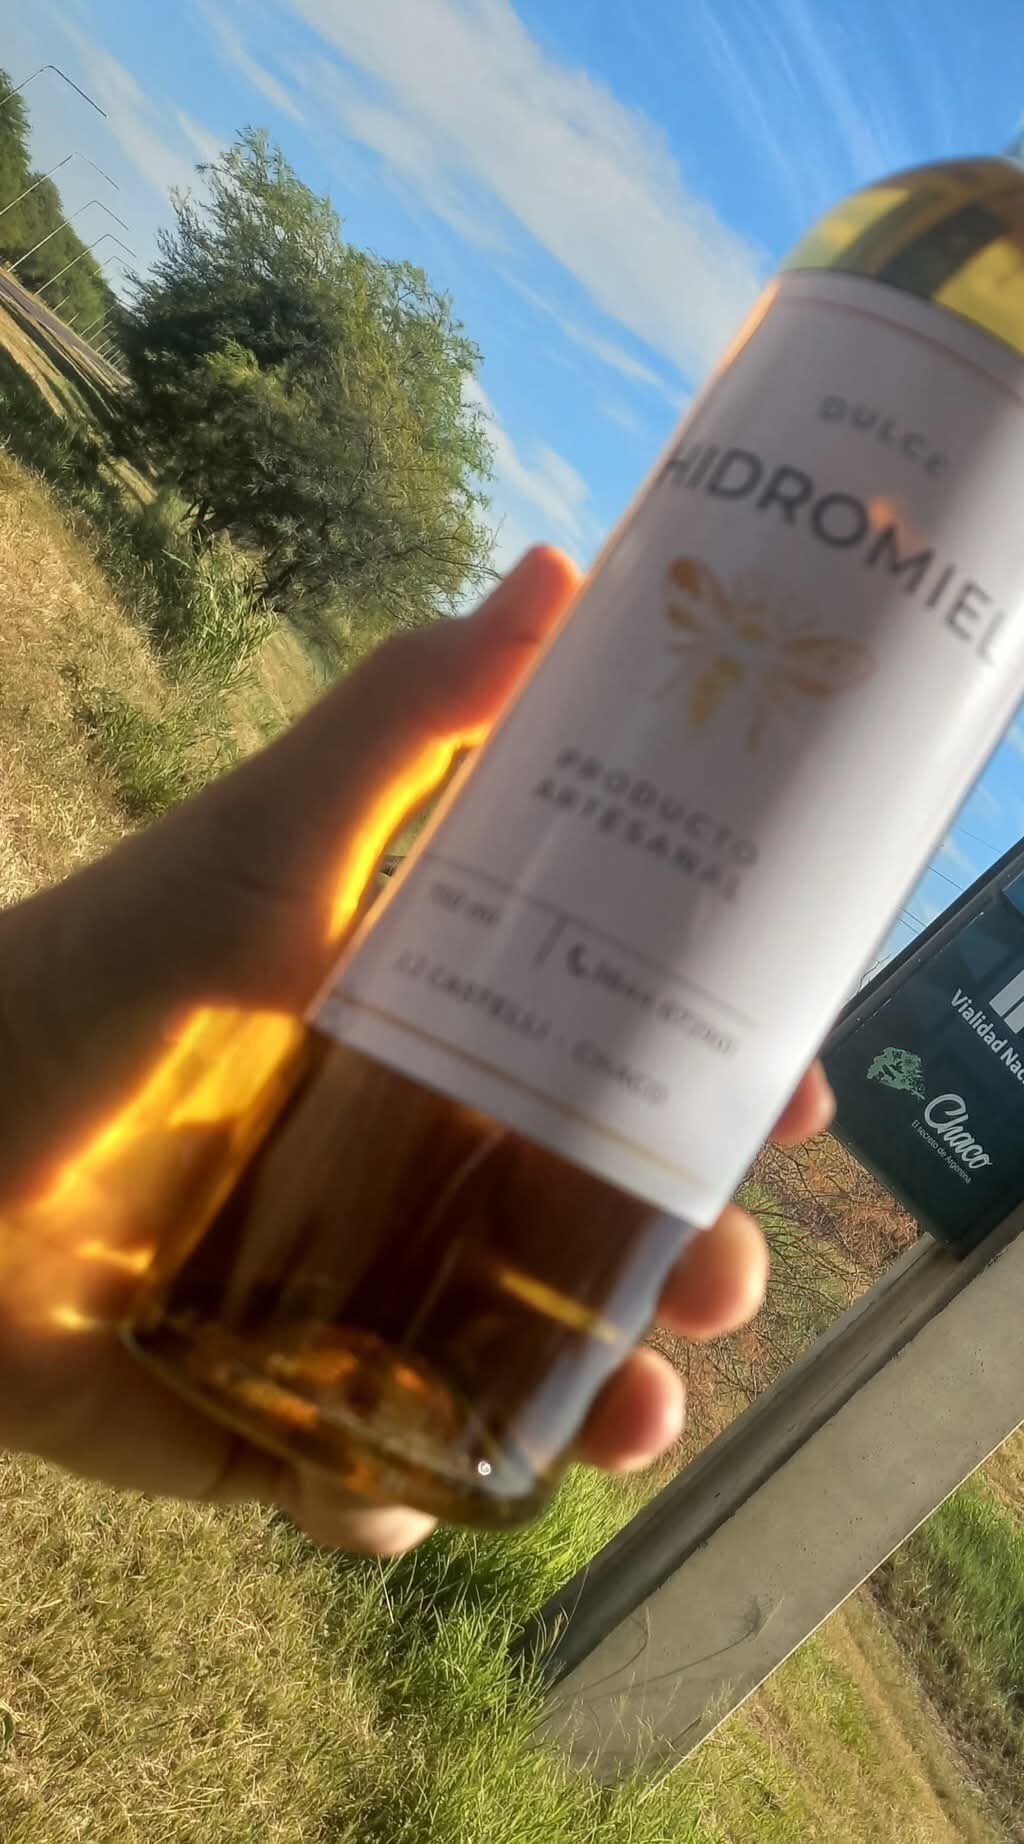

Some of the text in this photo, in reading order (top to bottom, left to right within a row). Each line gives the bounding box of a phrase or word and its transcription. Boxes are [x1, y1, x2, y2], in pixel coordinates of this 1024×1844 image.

[819, 395, 949, 481] DULCE
[657, 444, 1007, 665] HIDROMIEL
[556, 746, 759, 870] PRODUCTO
[951, 988, 1008, 1054] Vialidad
[924, 1093, 993, 1169] Chaco
[937, 1146, 947, 1158] de
